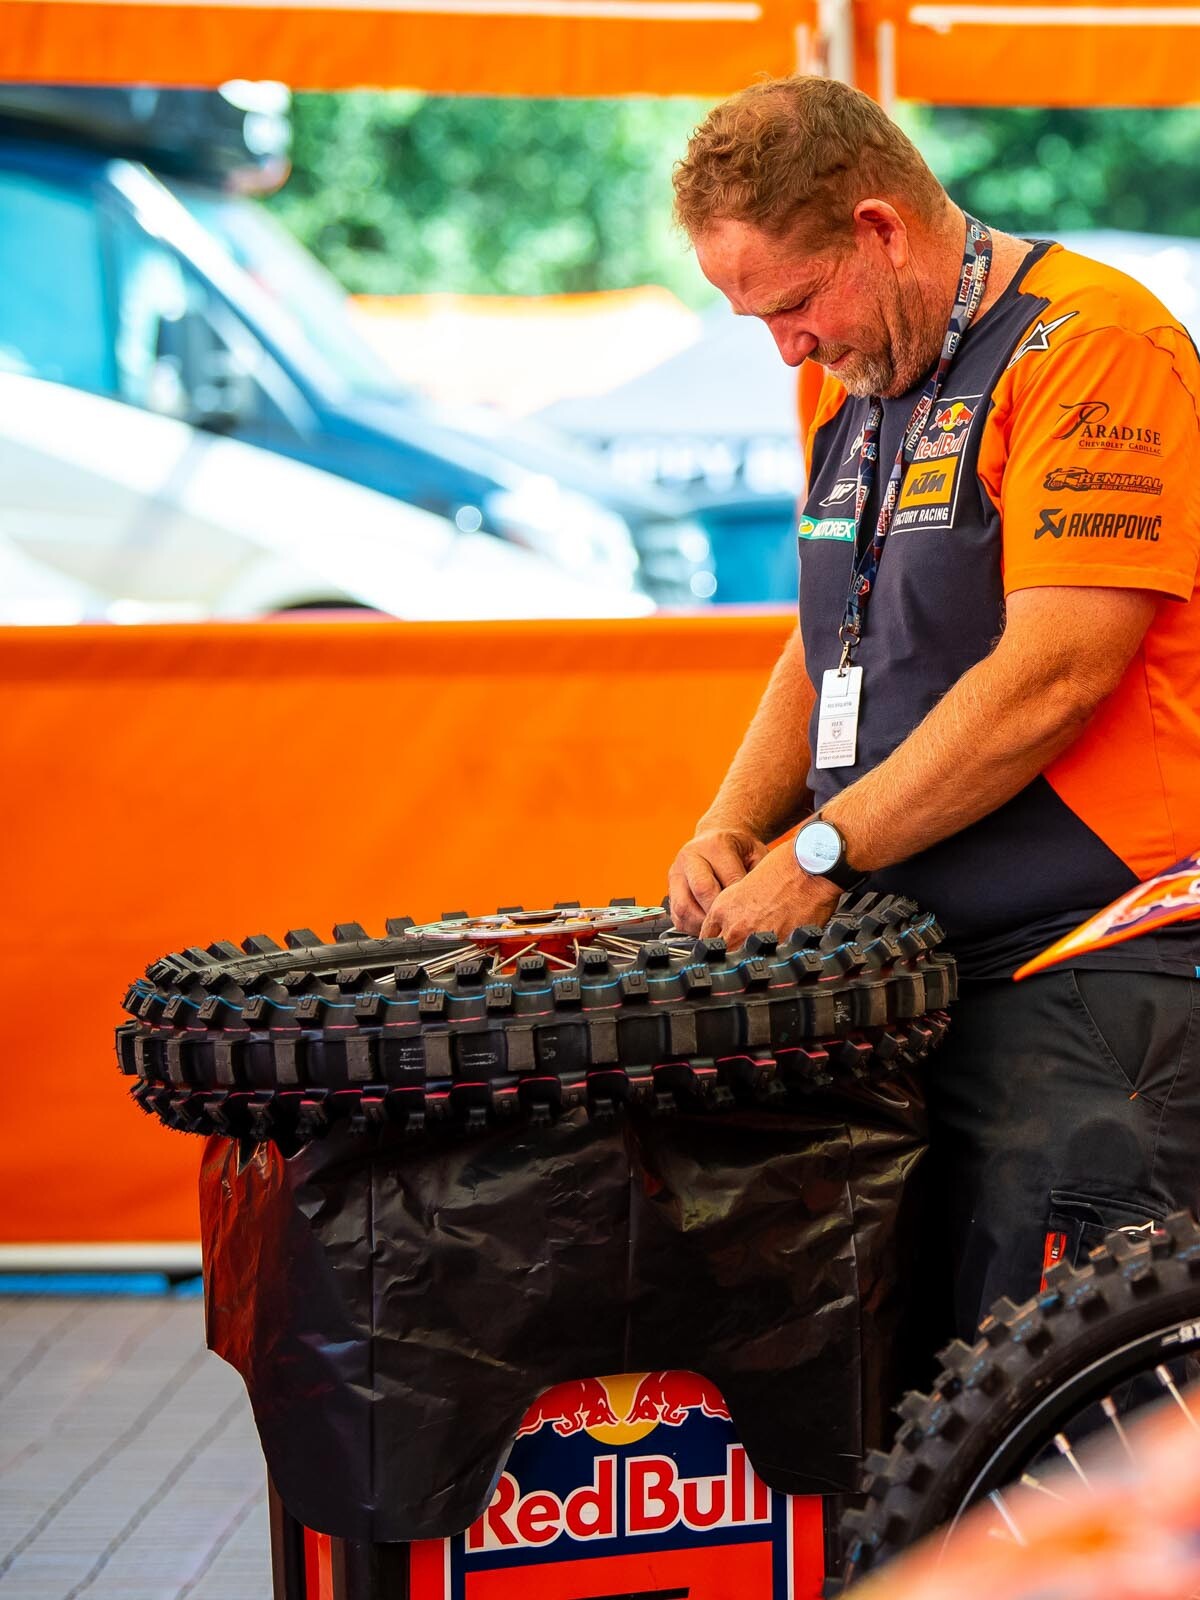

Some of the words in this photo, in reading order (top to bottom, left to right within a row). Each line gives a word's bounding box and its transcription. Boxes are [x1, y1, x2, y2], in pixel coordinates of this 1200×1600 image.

[1051, 401, 1161, 445] PARADISE
[913, 433, 942, 461] Red
[939, 427, 968, 456] Bull
[905, 469, 947, 498] KTM
[1079, 472, 1162, 488] RENTHAL
[918, 507, 949, 522] RACING
[1067, 512, 1162, 542] AKRAPOVIČ
[811, 520, 856, 539] MOTOREX
[465, 1468, 617, 1554] Red
[625, 1443, 772, 1536] Bull
